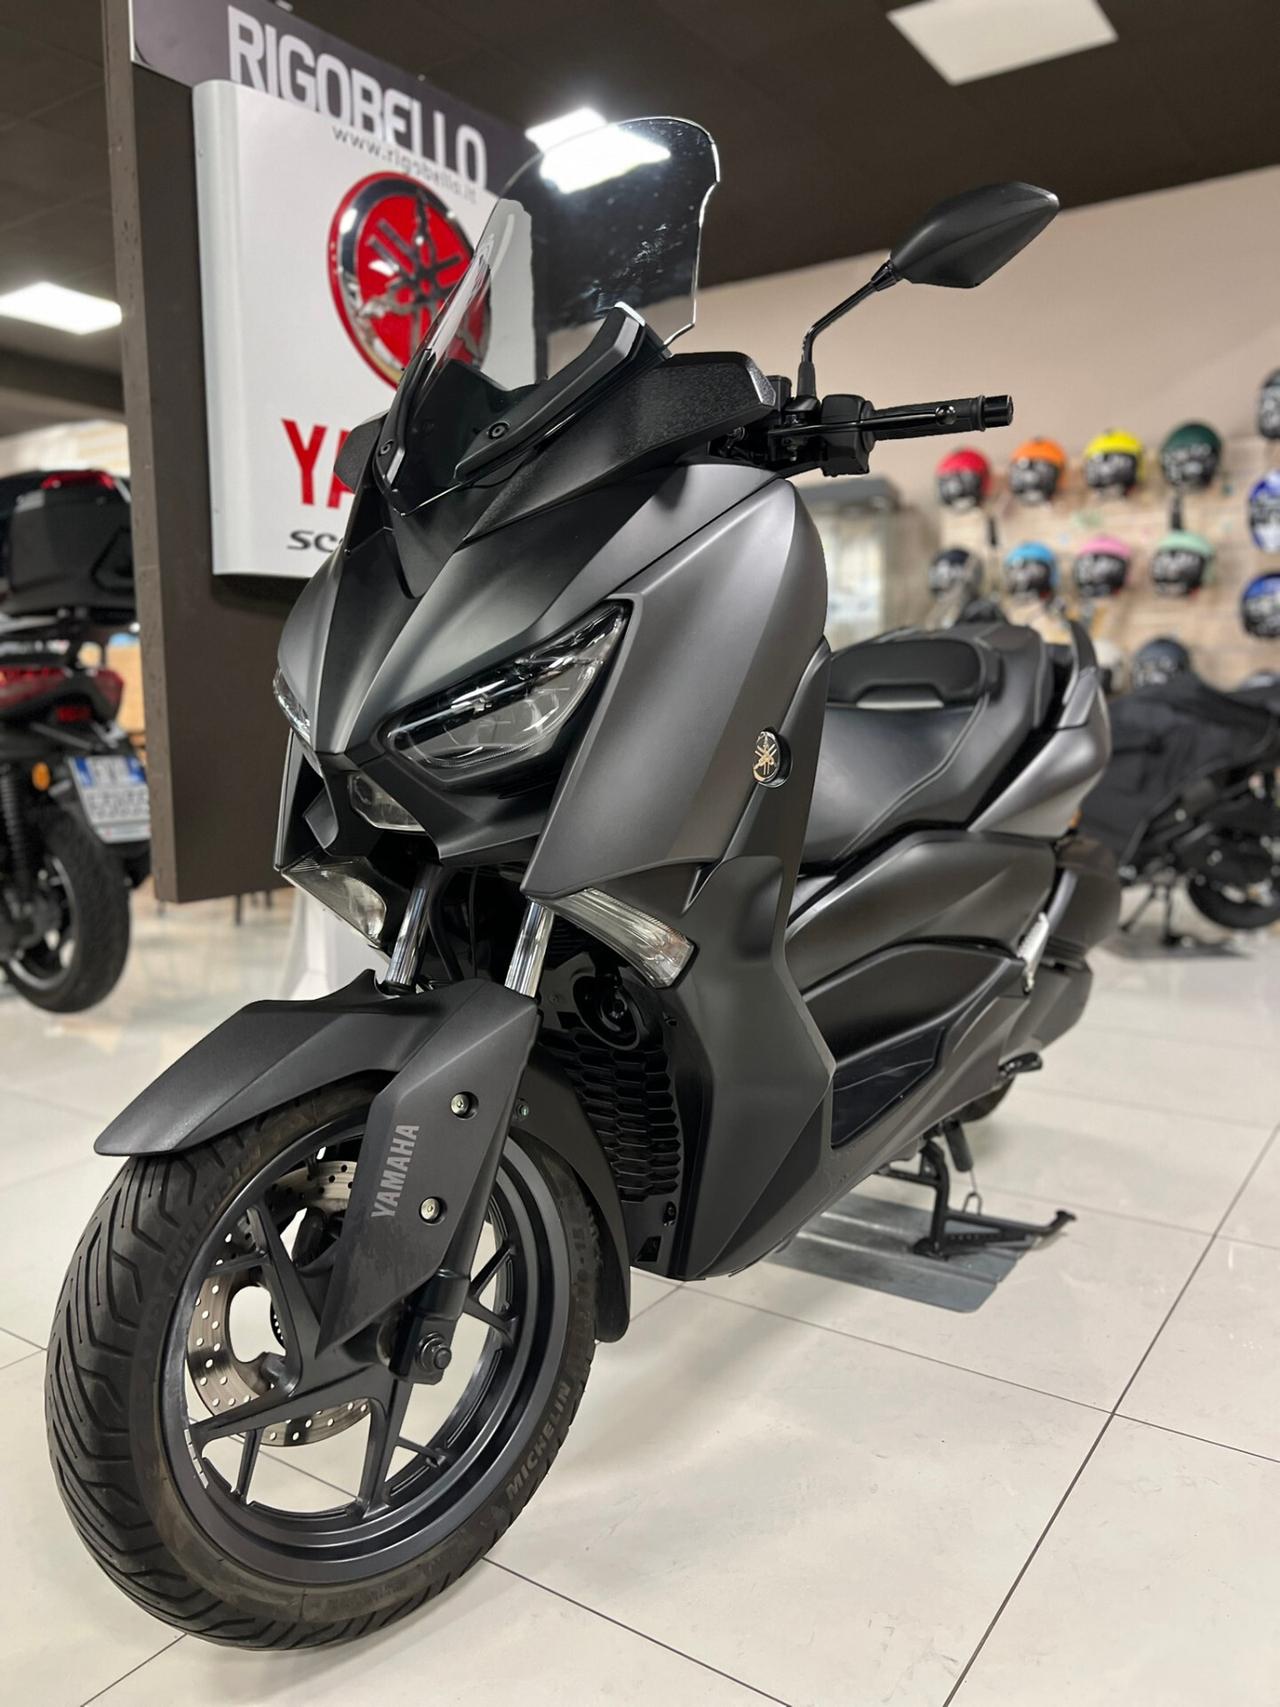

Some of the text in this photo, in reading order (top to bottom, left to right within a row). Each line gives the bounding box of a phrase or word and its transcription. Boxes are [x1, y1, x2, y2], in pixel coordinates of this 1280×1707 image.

[228, 5, 488, 191] RIGOBELLO
[371, 1125, 420, 1217] YAMAHA
[506, 1380, 572, 1500] MICHELIN
